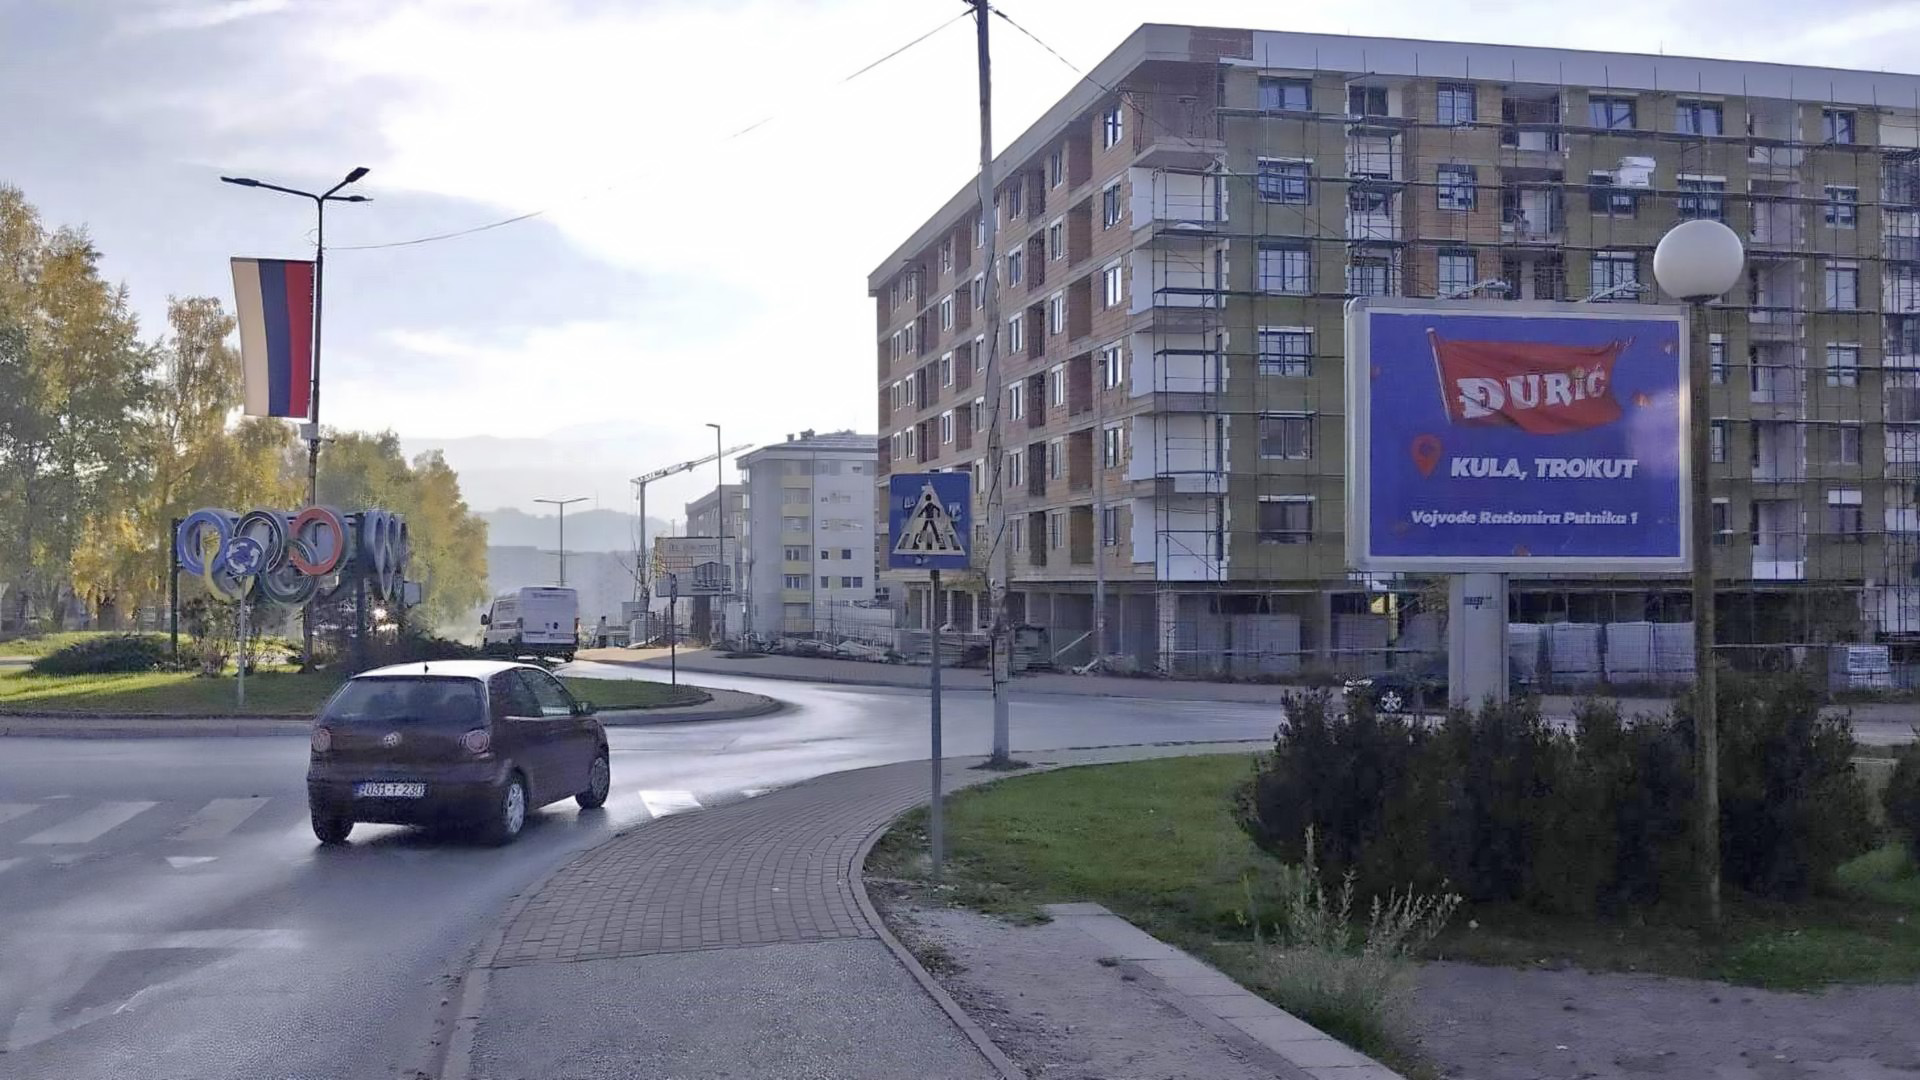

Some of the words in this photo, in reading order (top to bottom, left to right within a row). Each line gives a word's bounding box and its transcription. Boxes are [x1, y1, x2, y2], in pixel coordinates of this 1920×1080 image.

[1451, 458, 1527, 480] KULA,
[1535, 458, 1638, 478] TROKUT
[1411, 511, 1476, 527] Vojvode
[1480, 510, 1560, 524] Radomira
[1631, 512, 1638, 524] 1
